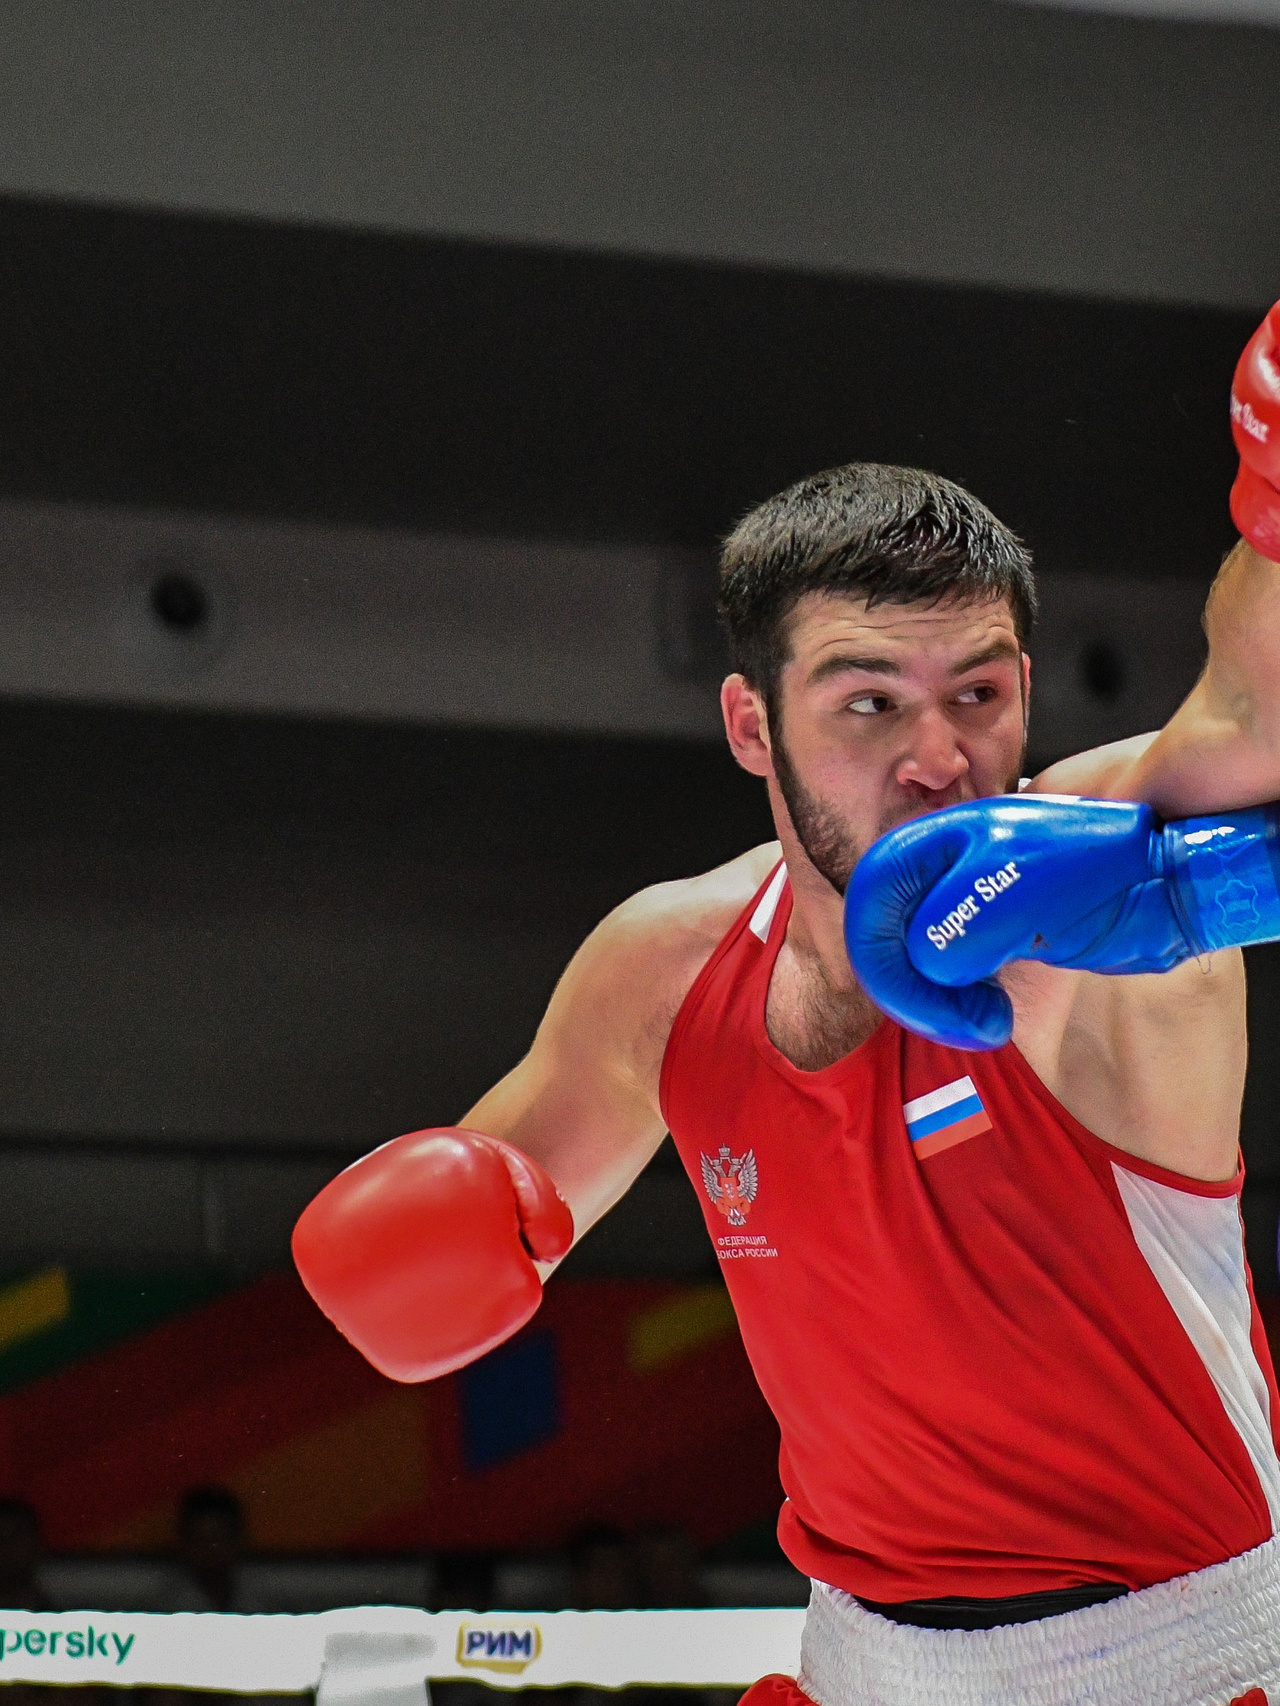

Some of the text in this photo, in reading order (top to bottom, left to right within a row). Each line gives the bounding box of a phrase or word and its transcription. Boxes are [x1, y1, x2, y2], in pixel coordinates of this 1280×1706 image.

[926, 861, 1021, 951] Super Star
[717, 1235, 768, 1247] ФЕДЕРАЦИЯ
[745, 1248, 779, 1258] РОССИИ
[466, 1630, 532, 1656] РИМ
